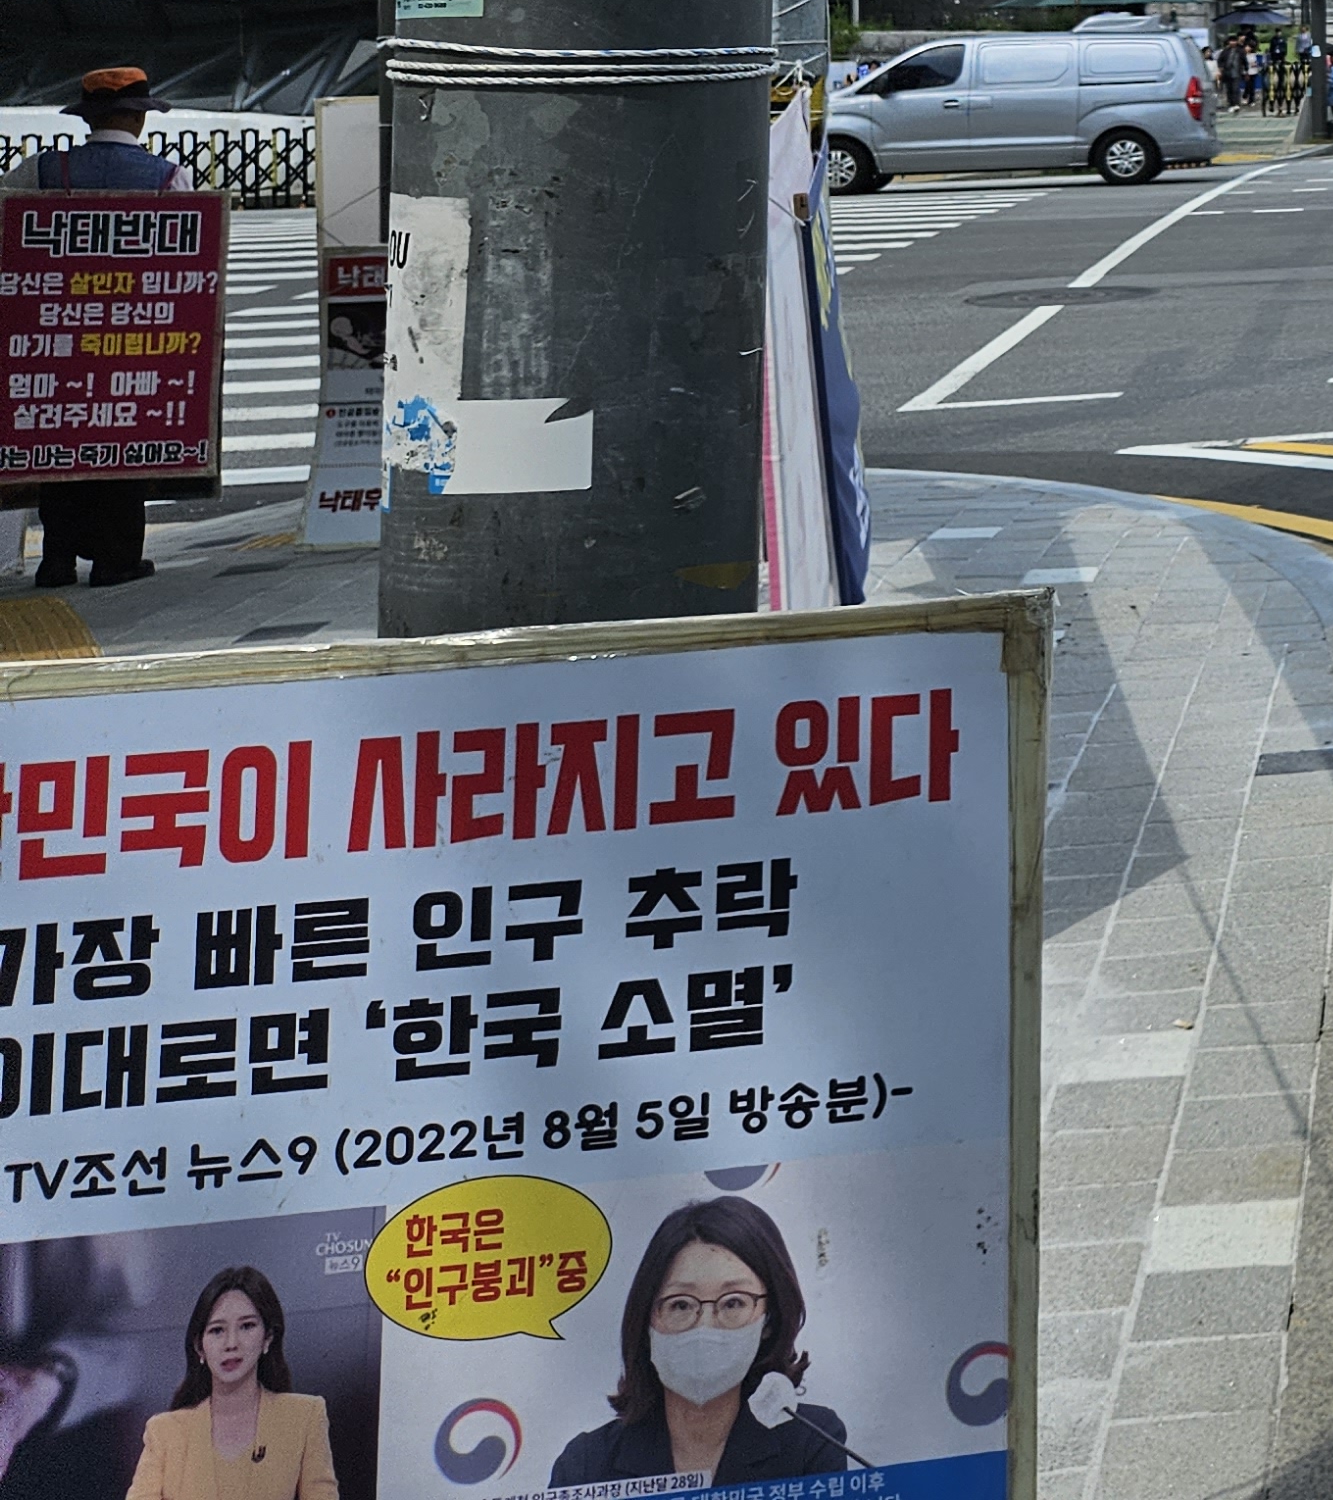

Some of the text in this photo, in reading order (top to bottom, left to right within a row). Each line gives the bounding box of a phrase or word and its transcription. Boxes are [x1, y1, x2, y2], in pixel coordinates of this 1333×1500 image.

[22, 210, 201, 258] 낙태반대
[0, 270, 219, 296] 당신은 살인자 입니까?
[39, 301, 175, 327] 당신은 당신의
[8, 333, 74, 358] 아기를
[8, 372, 59, 399] 엄마
[110, 370, 161, 396] 아빠
[13, 401, 138, 430] 살려주세요
[32, 444, 75, 470] 나는
[79, 442, 121, 467] 죽기
[0, 688, 959, 881] 민국이 사라지고 있다
[0, 857, 798, 1008] 가장 빠른 인구 추락
[0, 1008, 330, 1120] 이대로면
[5, 1071, 914, 1204] TV조선 뉴스9 (2022년 8월 5일 방송분)-
[315, 1238, 373, 1257] CHOSUN
[325, 1231, 342, 1242] TV
[405, 1208, 504, 1258] 한국은
[328, 1256, 362, 1272] 뉴스9
[671, 1472, 705, 1490] 28일)
[769, 1481, 805, 1500] 정부
[809, 1475, 845, 1498] 수립
[850, 1470, 885, 1494] 이후
